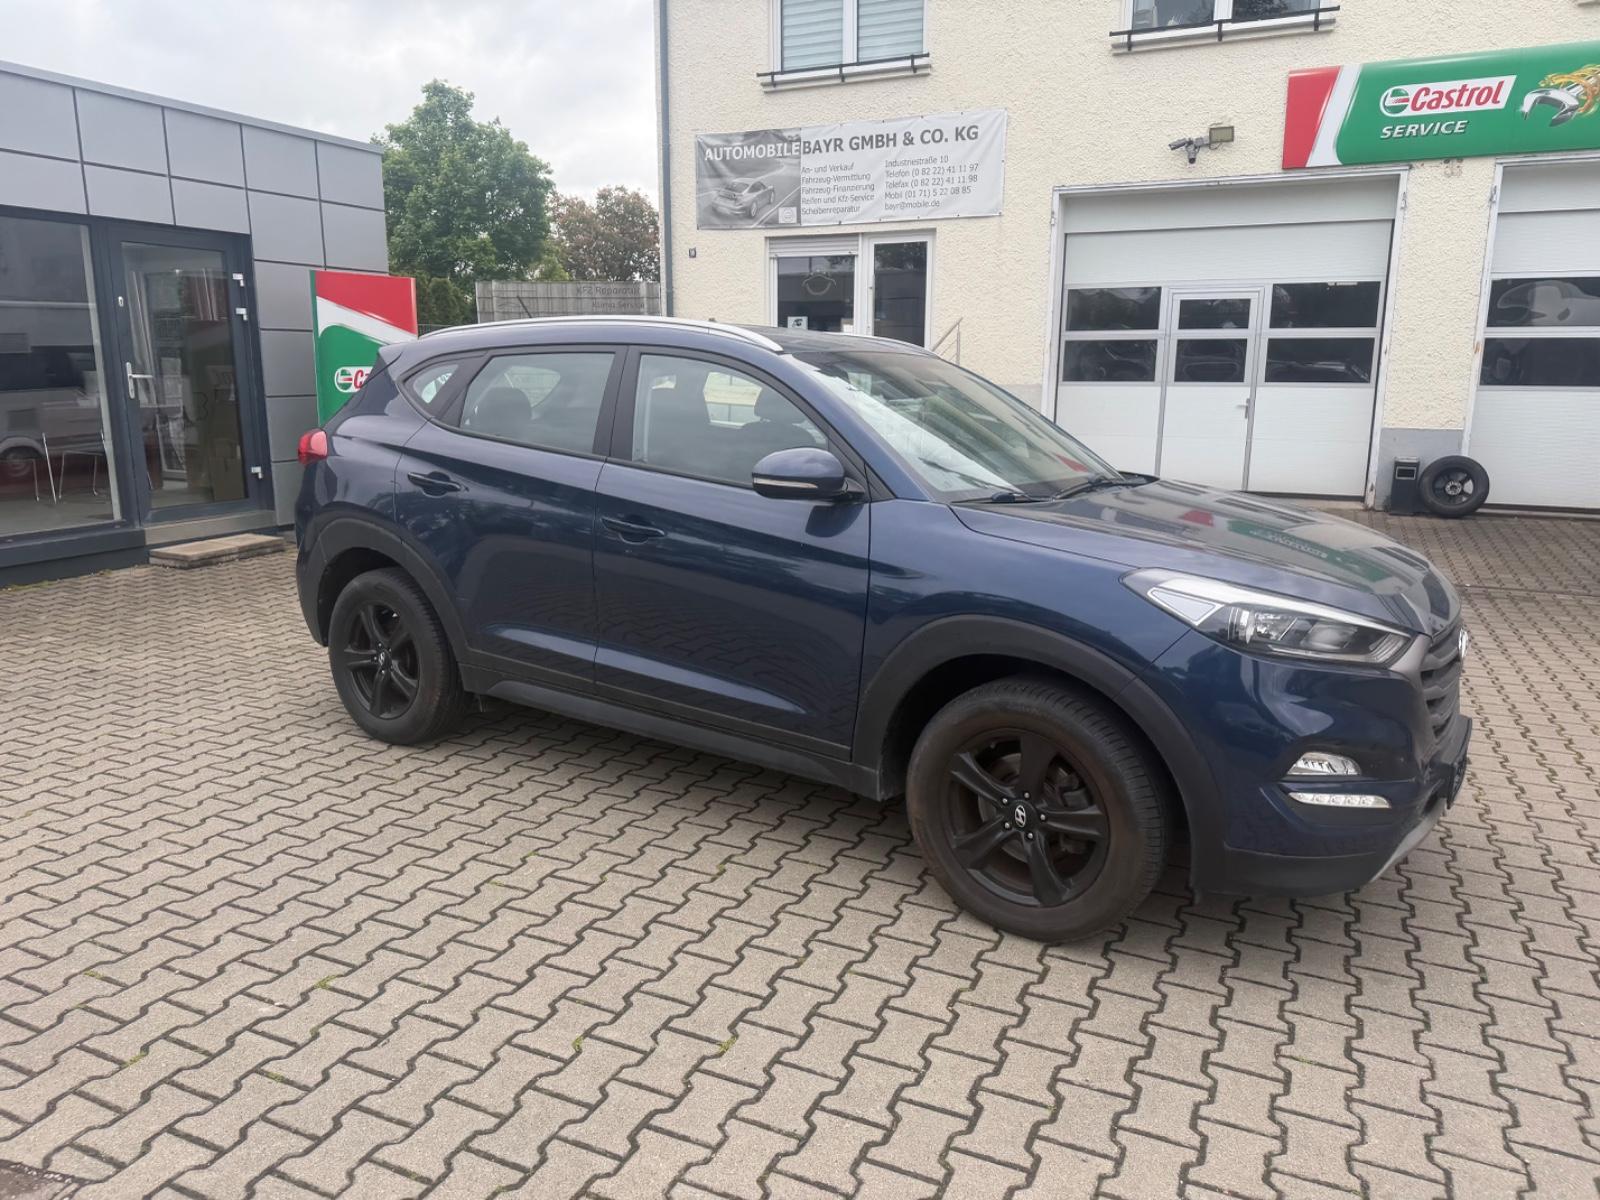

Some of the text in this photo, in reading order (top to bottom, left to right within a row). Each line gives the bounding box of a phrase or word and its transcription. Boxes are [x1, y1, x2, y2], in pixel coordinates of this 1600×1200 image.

[1411, 81, 1504, 111] Castrol
[1380, 120, 1468, 139] SERVICE
[705, 125, 979, 160] AUTOMOBILE BAYR GMBH & CO. KG
[814, 165, 828, 173] und
[829, 162, 854, 172] Verkauf
[885, 155, 949, 167] Industriestraße 10
[885, 169, 910, 178] Telefon
[912, 168, 919, 178] (0
[921, 167, 931, 176] 82
[932, 166, 945, 176] 22)
[947, 165, 955, 173] 41
[969, 163, 979, 172] 97
[885, 174, 978, 189] Telefax (0 82 22) 41 11 98
[823, 195, 837, 203] und
[884, 191, 903, 199] Mobil
[905, 190, 916, 199] (01
[919, 189, 930, 198] 71)
[932, 188, 938, 197] 5
[961, 185, 971, 194] 85
[801, 206, 861, 215] Scheibenreparatur
[884, 200, 941, 210] bayr@mobile.de
